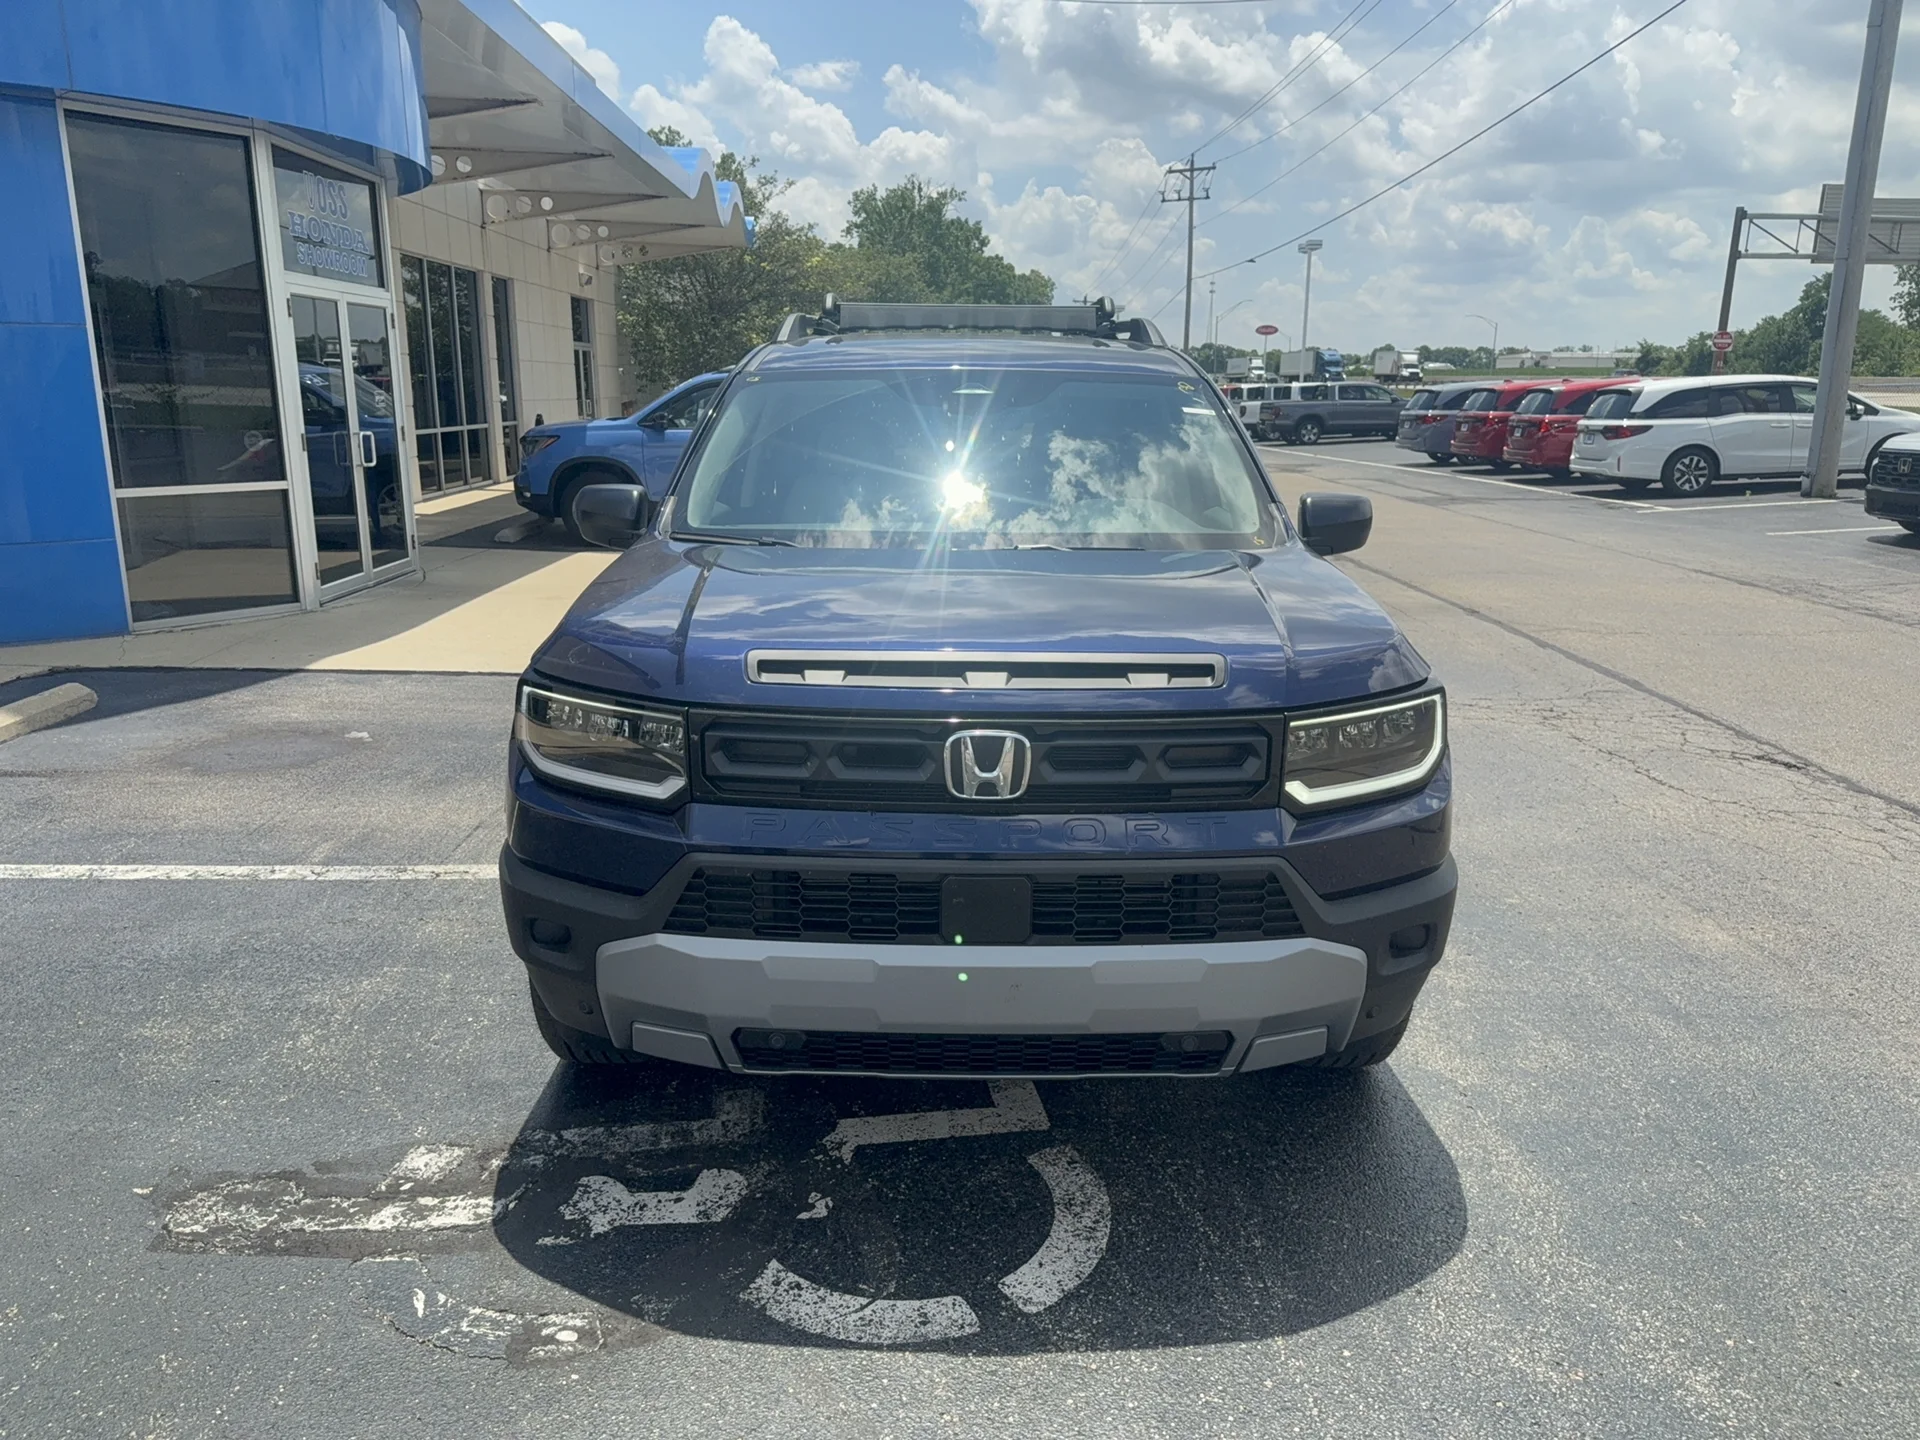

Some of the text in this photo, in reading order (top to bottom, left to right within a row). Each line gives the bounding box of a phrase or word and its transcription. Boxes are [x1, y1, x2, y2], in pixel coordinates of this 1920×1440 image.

[302, 170, 349, 221] VOSS
[288, 210, 370, 254] HONDA
[297, 242, 368, 277] SHOWROOM
[740, 811, 1229, 848] PASSPORT
